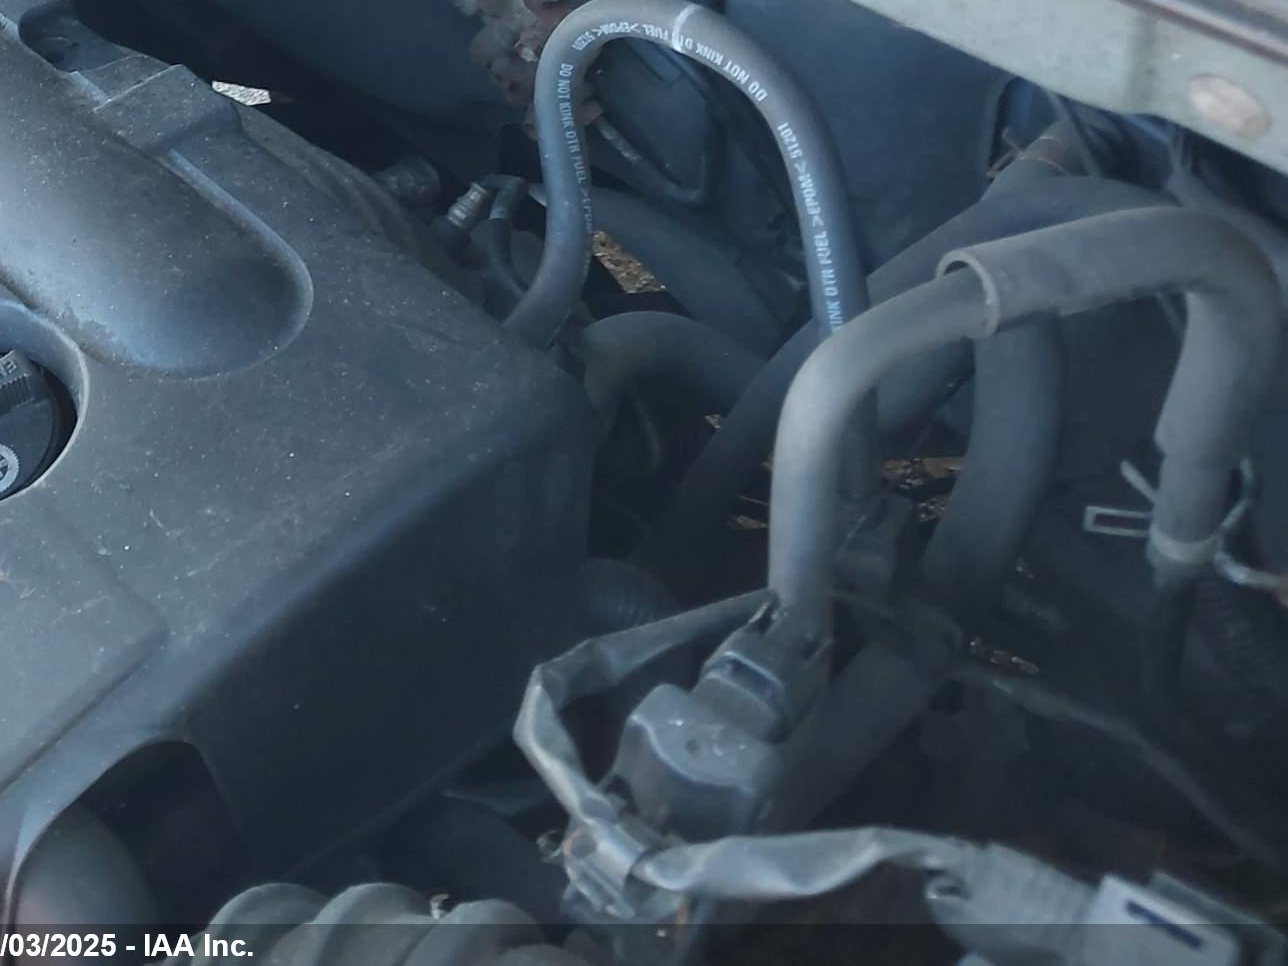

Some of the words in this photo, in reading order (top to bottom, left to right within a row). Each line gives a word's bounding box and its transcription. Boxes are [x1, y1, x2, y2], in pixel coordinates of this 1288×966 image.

[643, 23, 669, 41] FUEL
[695, 41, 723, 65] KINK
[559, 64, 573, 77] DO
[722, 58, 749, 82] NOT
[557, 78, 571, 99] NOT
[747, 81, 768, 102] DO
[560, 102, 576, 128] KINK
[813, 231, 833, 265] FUEL
